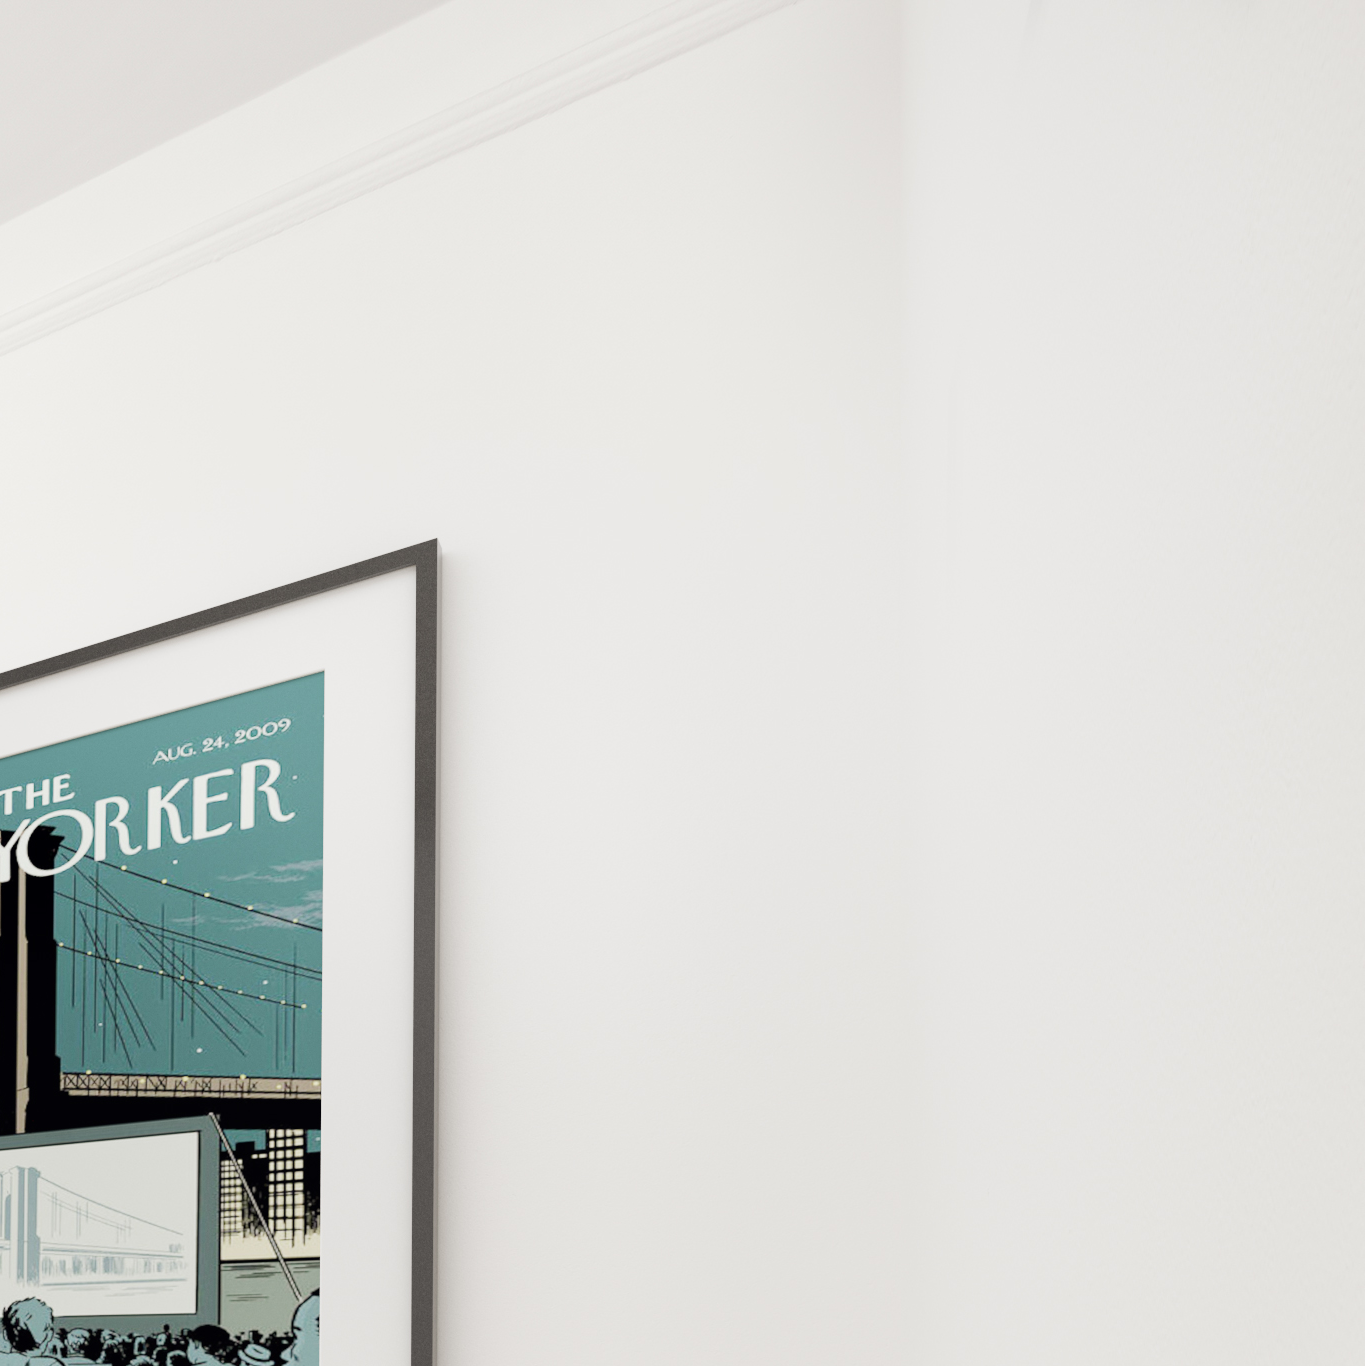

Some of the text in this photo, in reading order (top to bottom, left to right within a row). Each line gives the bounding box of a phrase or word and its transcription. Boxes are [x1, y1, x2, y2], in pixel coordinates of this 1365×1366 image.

[152, 718, 292, 765] AUG. 24, 2009
